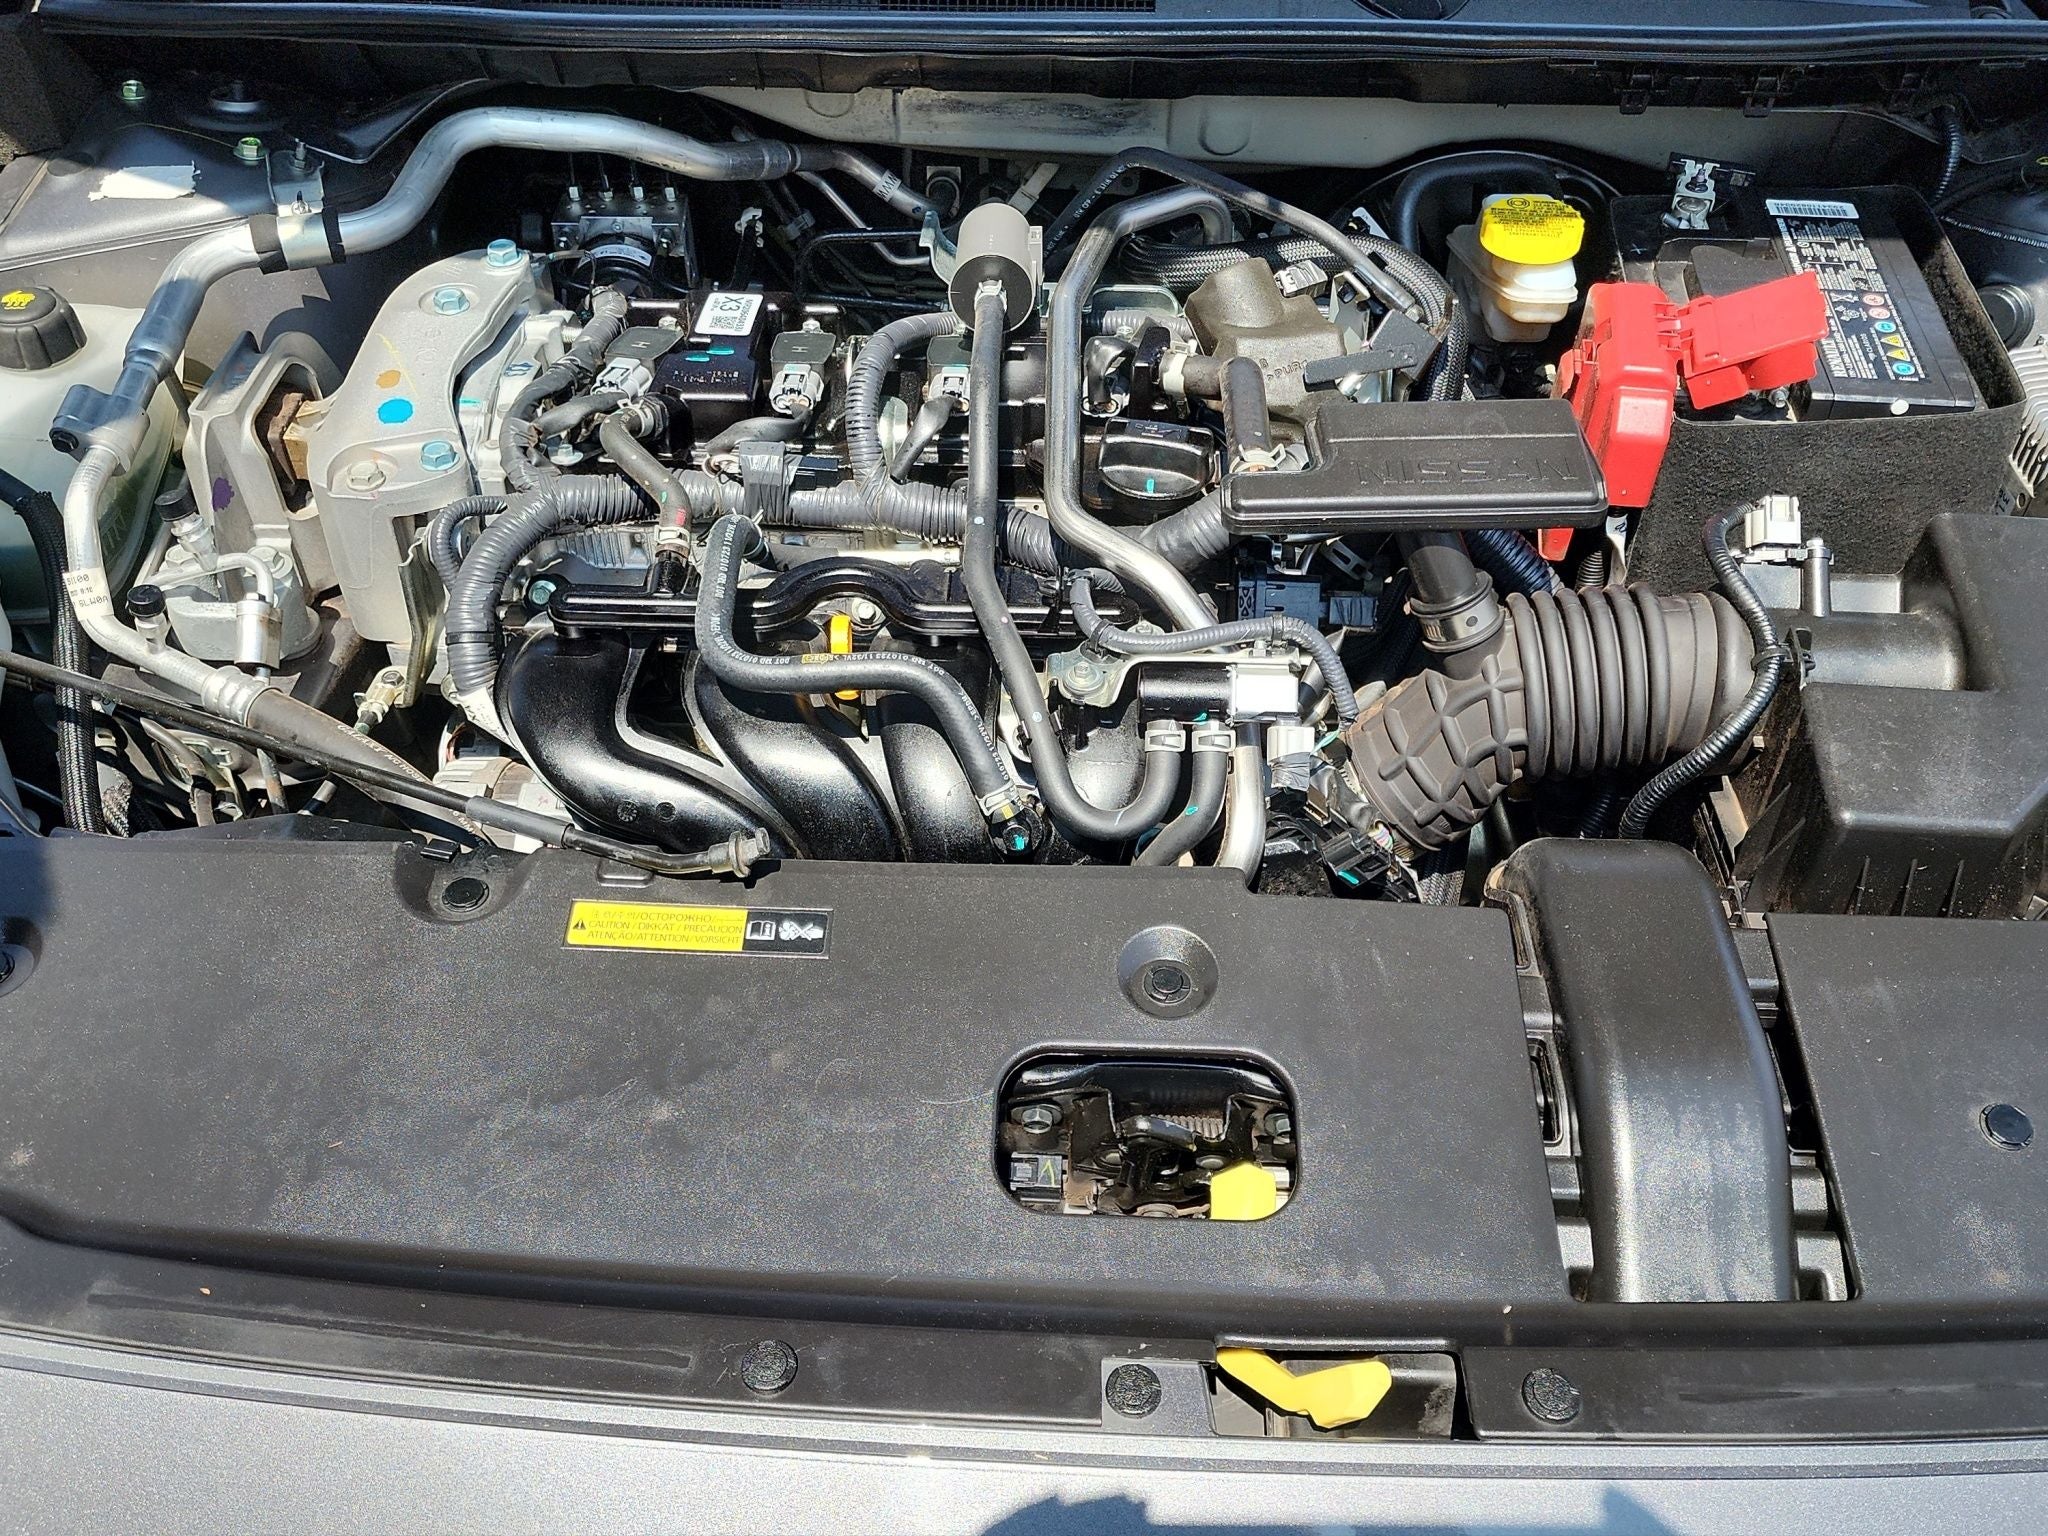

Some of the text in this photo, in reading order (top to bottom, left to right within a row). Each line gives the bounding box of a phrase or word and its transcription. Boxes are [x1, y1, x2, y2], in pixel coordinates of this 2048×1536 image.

[719, 296, 745, 312] X3
[1350, 456, 1579, 486] NISSAN
[588, 920, 630, 930] CAUTION
[638, 922, 674, 931] DIKKAT
